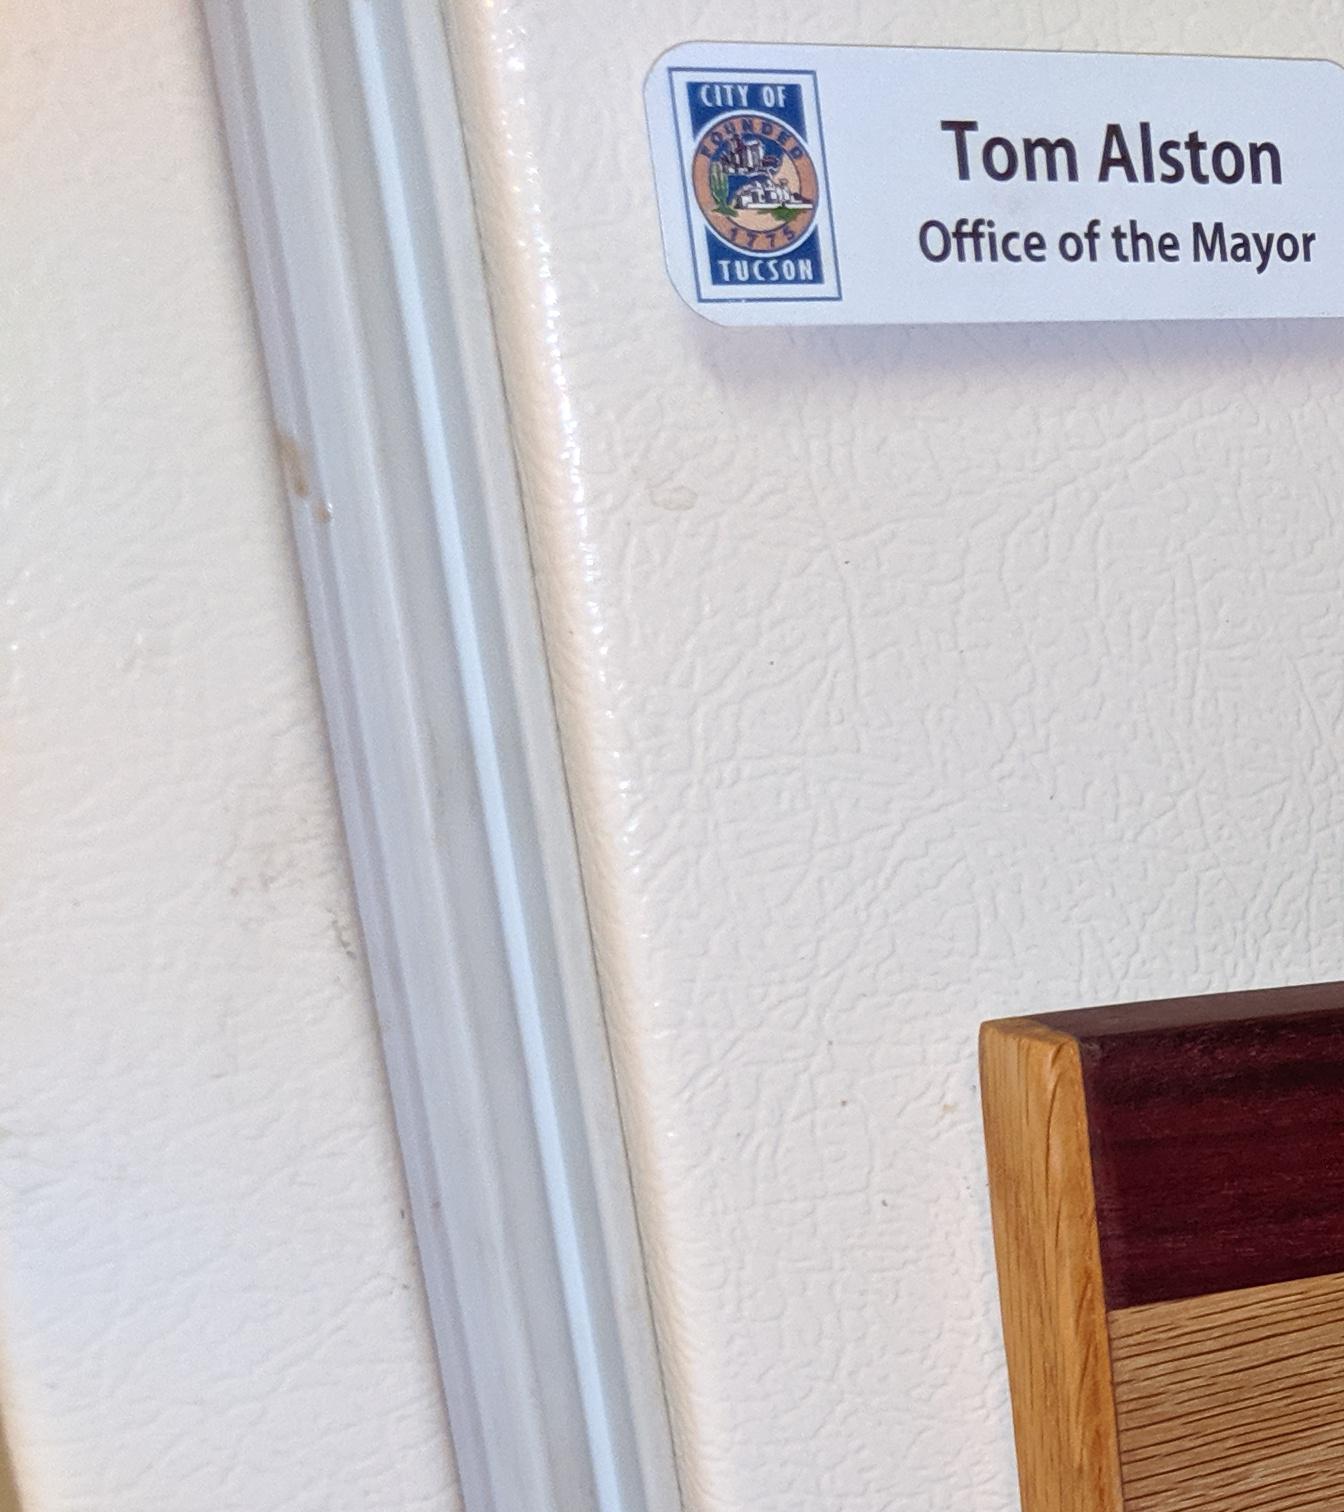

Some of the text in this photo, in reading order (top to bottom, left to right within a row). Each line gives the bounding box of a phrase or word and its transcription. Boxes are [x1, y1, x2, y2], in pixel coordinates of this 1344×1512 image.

[700, 84, 786, 108] CITY OF
[700, 117, 802, 159] FOUNDED
[940, 119, 1283, 185] Tom Alston
[729, 227, 796, 249] 1775
[918, 217, 1317, 275] Office of the Mayor
[718, 259, 814, 282] TUCSON
